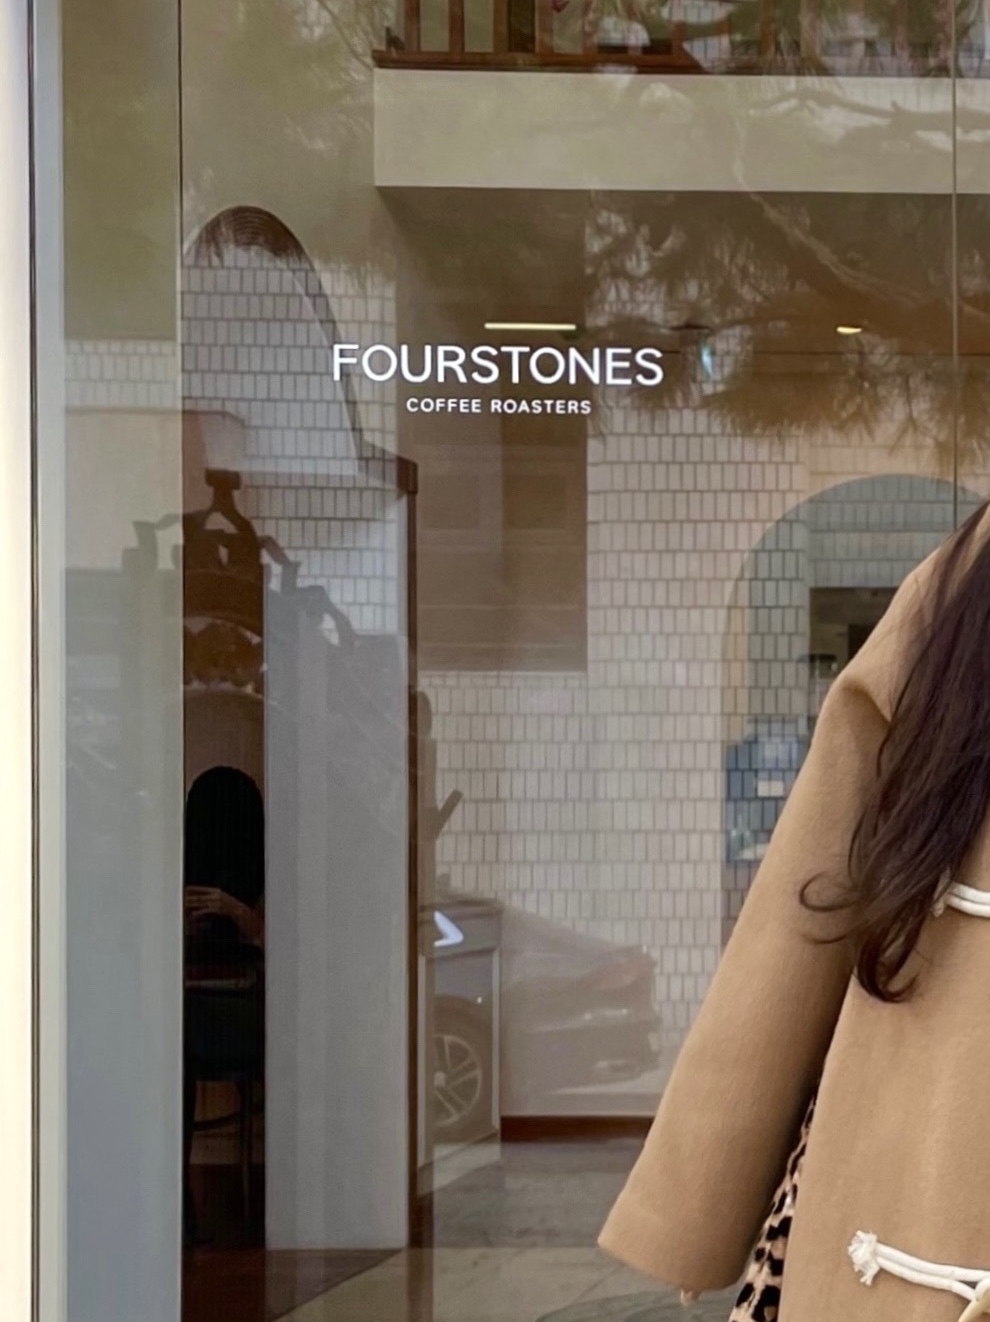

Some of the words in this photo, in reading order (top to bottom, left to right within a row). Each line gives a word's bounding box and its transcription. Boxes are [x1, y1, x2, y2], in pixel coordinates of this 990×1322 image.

[332, 344, 664, 386] FOURSTONES
[406, 398, 482, 413] COFFEE
[490, 399, 592, 415] ROASTERS
